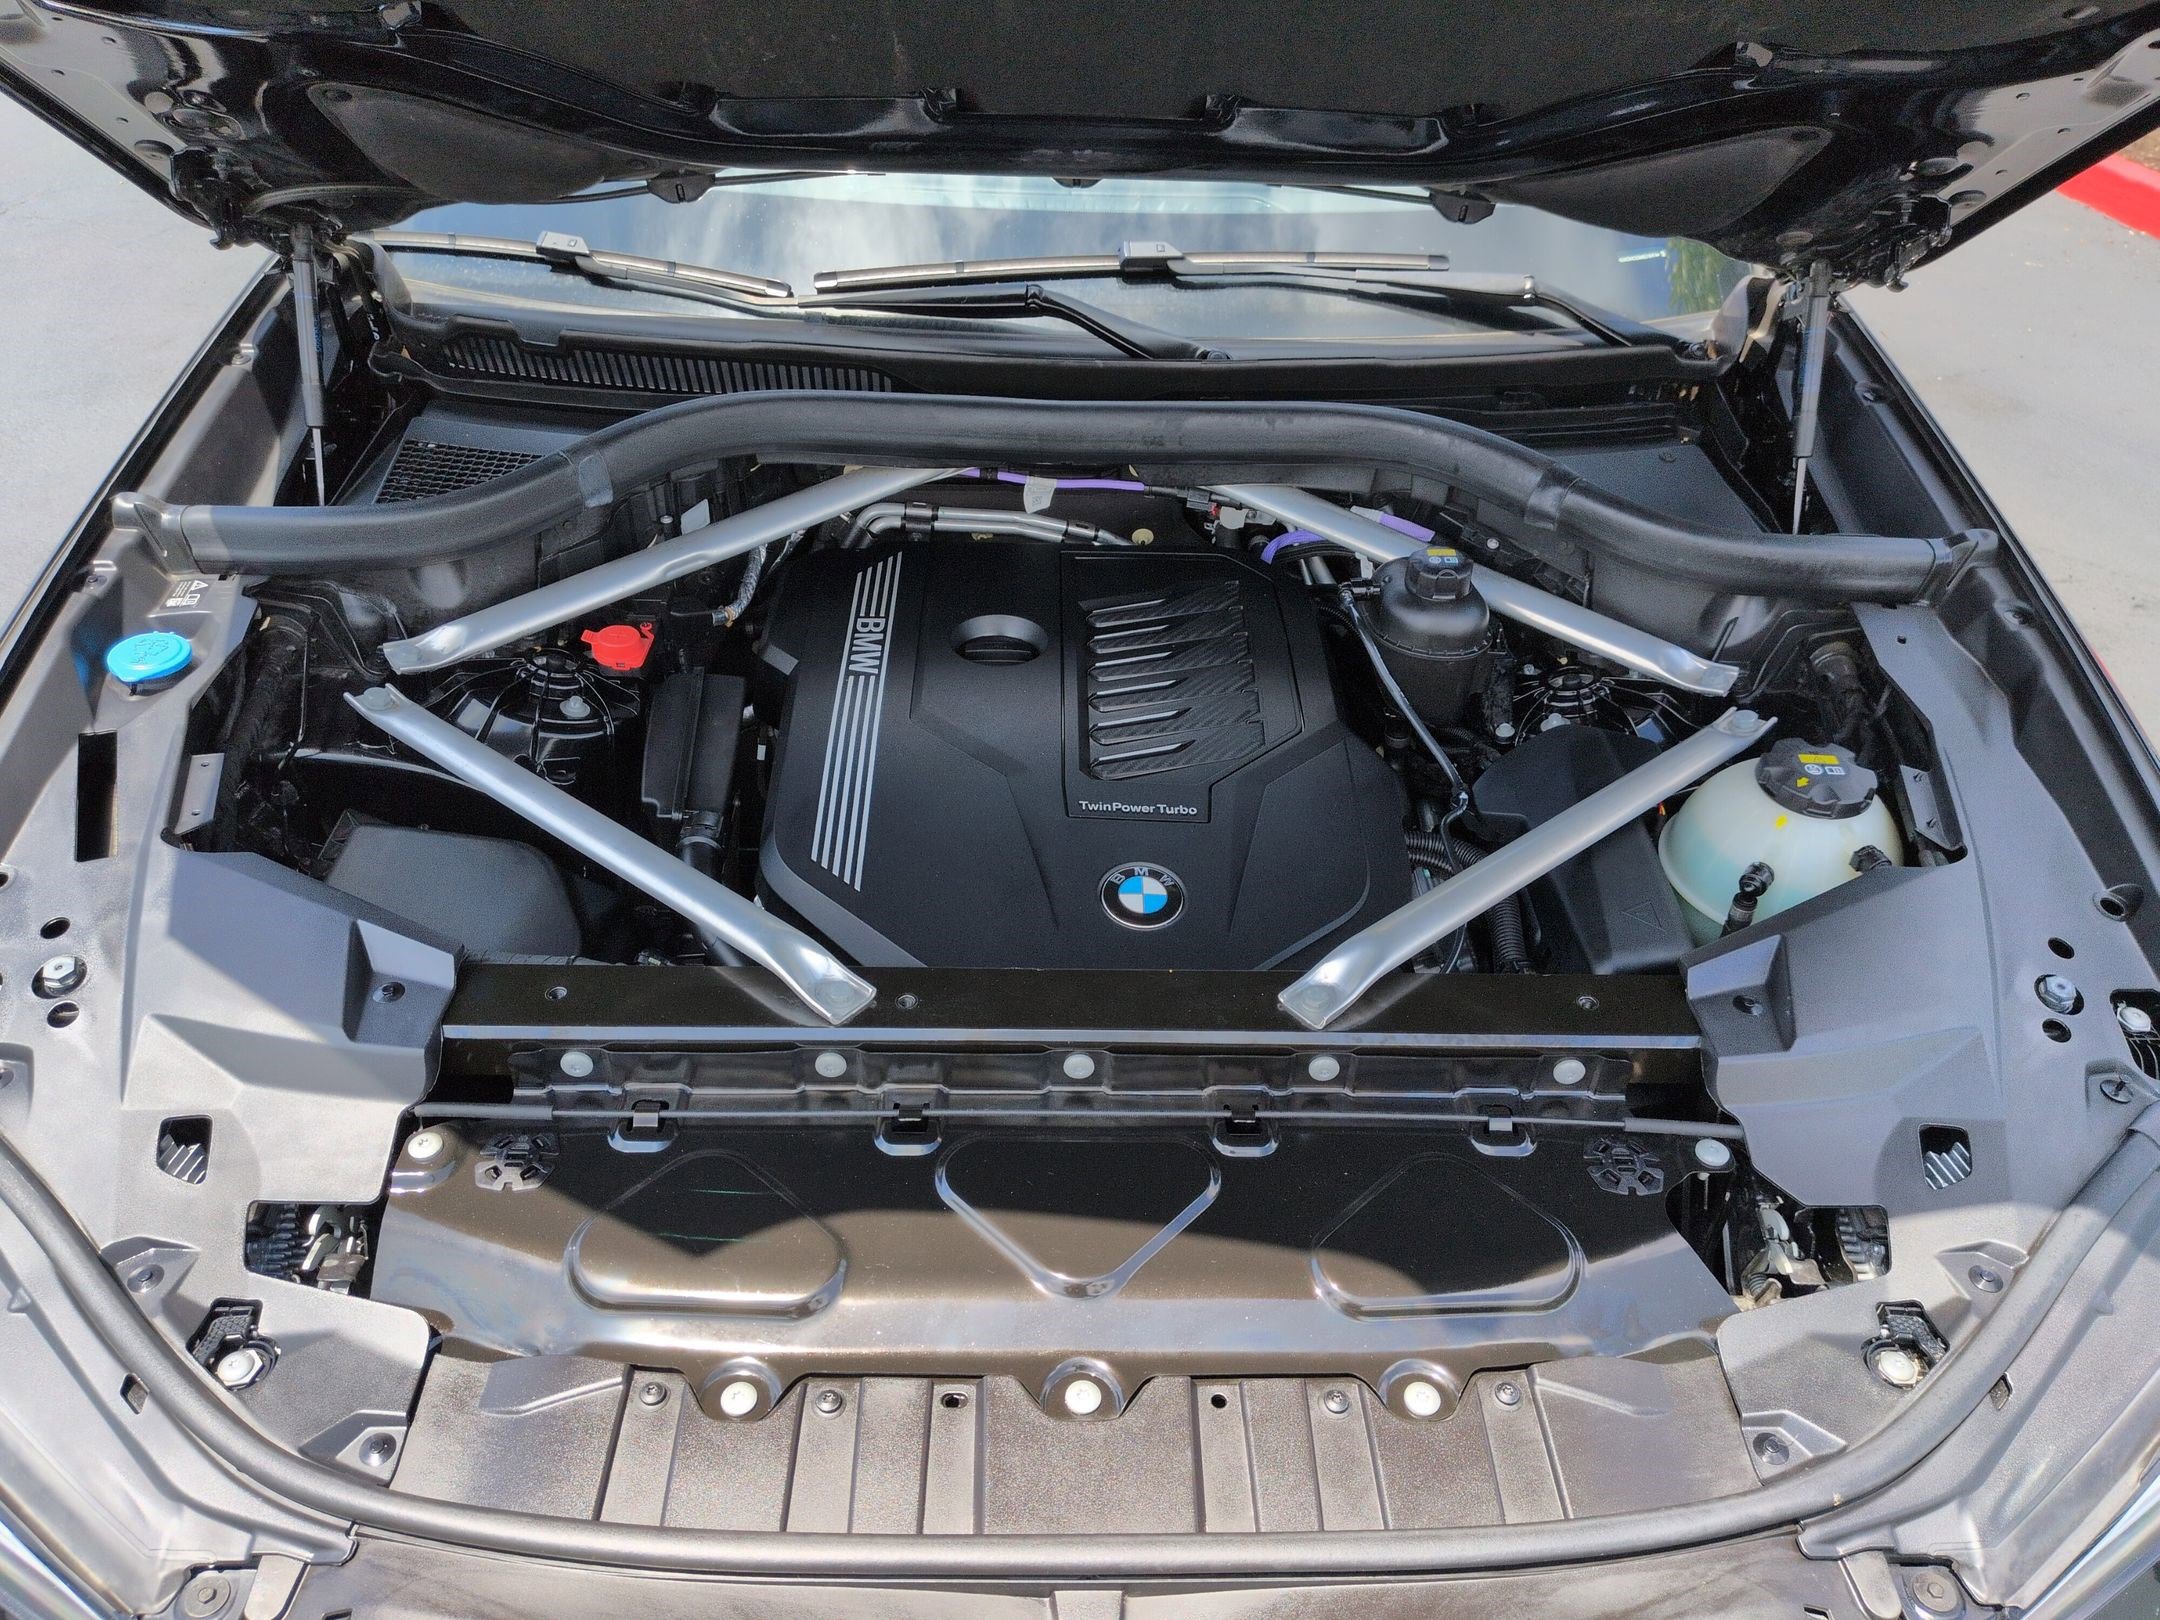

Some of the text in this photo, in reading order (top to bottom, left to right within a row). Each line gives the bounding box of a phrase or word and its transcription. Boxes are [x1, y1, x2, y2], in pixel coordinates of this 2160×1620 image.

[848, 617, 886, 674] BMW
[1079, 800, 1198, 815] TwinPower Turbo
[1110, 866, 1175, 888] BMW
